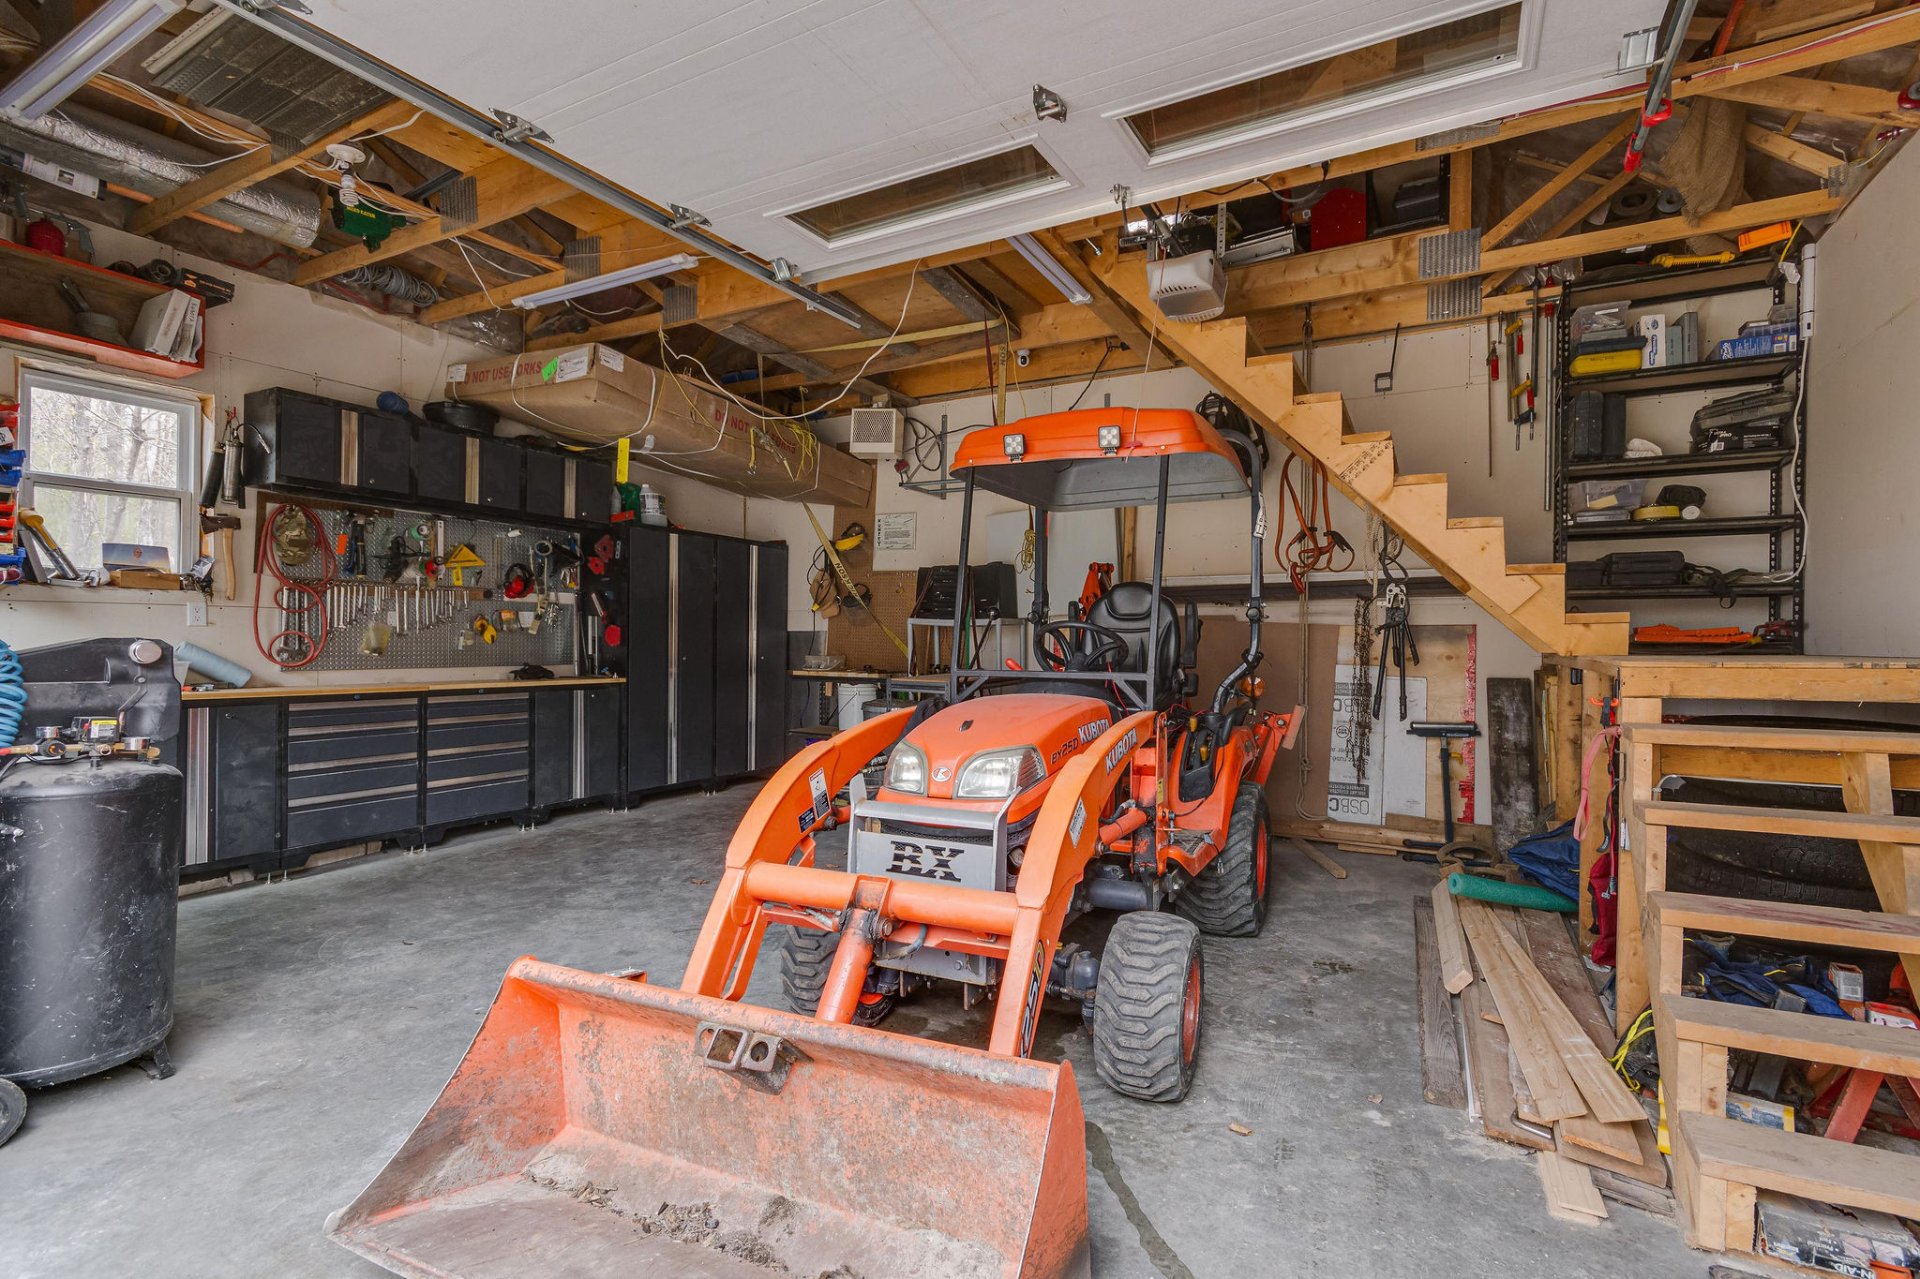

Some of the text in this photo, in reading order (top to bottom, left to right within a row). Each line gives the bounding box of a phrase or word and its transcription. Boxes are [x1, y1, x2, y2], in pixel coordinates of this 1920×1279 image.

[471, 370, 491, 384] NOT
[492, 366, 511, 380] USE
[511, 361, 543, 377] ORKS
[730, 415, 749, 433] NOT
[1078, 719, 1110, 746] KUBOTA
[1105, 727, 1138, 776] KUBOTA
[886, 840, 965, 883] BX
